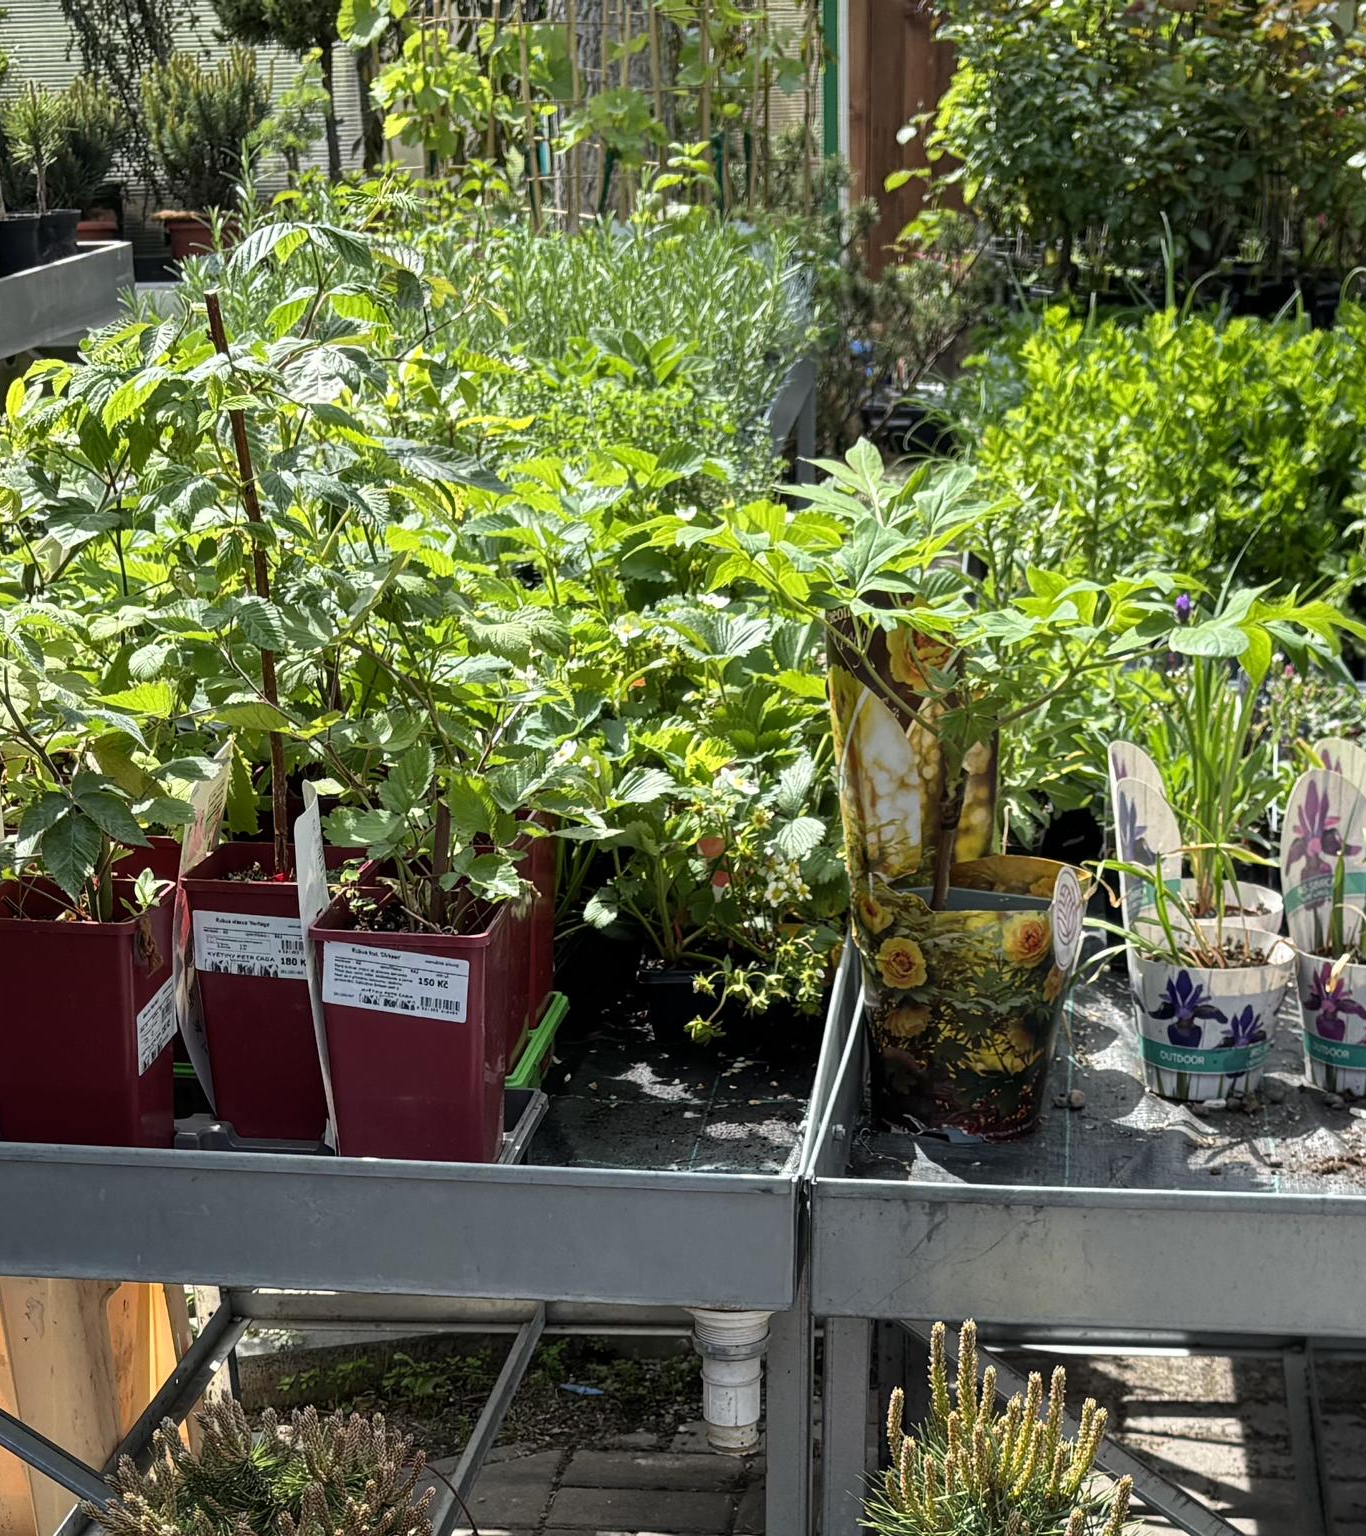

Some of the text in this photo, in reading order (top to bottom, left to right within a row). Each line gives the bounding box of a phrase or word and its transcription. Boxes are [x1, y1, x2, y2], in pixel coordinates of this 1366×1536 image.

[281, 957, 298, 966] 180
[418, 977, 449, 989] 150 Kč
[1159, 1050, 1205, 1065] OUTDOOR
